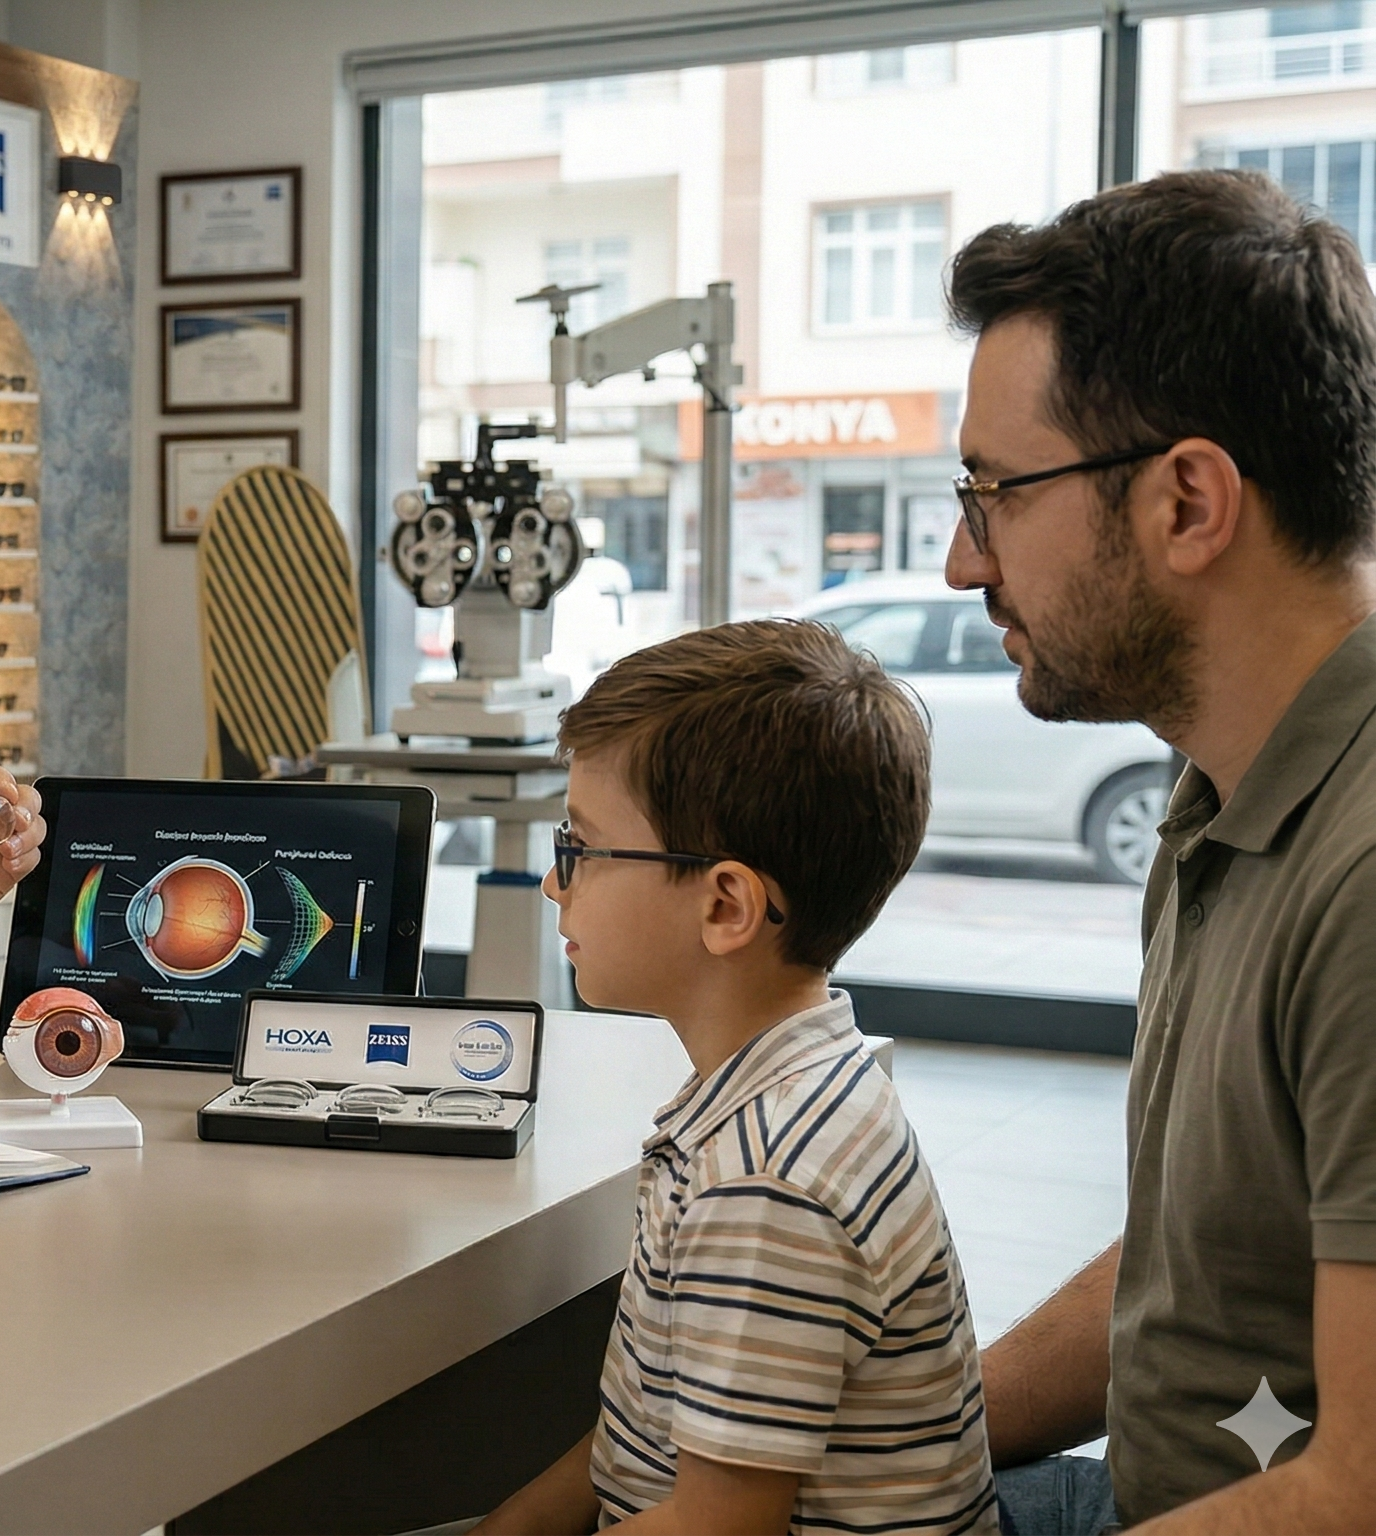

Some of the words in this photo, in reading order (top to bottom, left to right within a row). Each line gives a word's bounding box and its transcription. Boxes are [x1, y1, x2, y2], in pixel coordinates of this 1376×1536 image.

[732, 398, 898, 446] KONYA
[265, 1028, 333, 1047] HOXA
[368, 1034, 408, 1046] ZEISS
